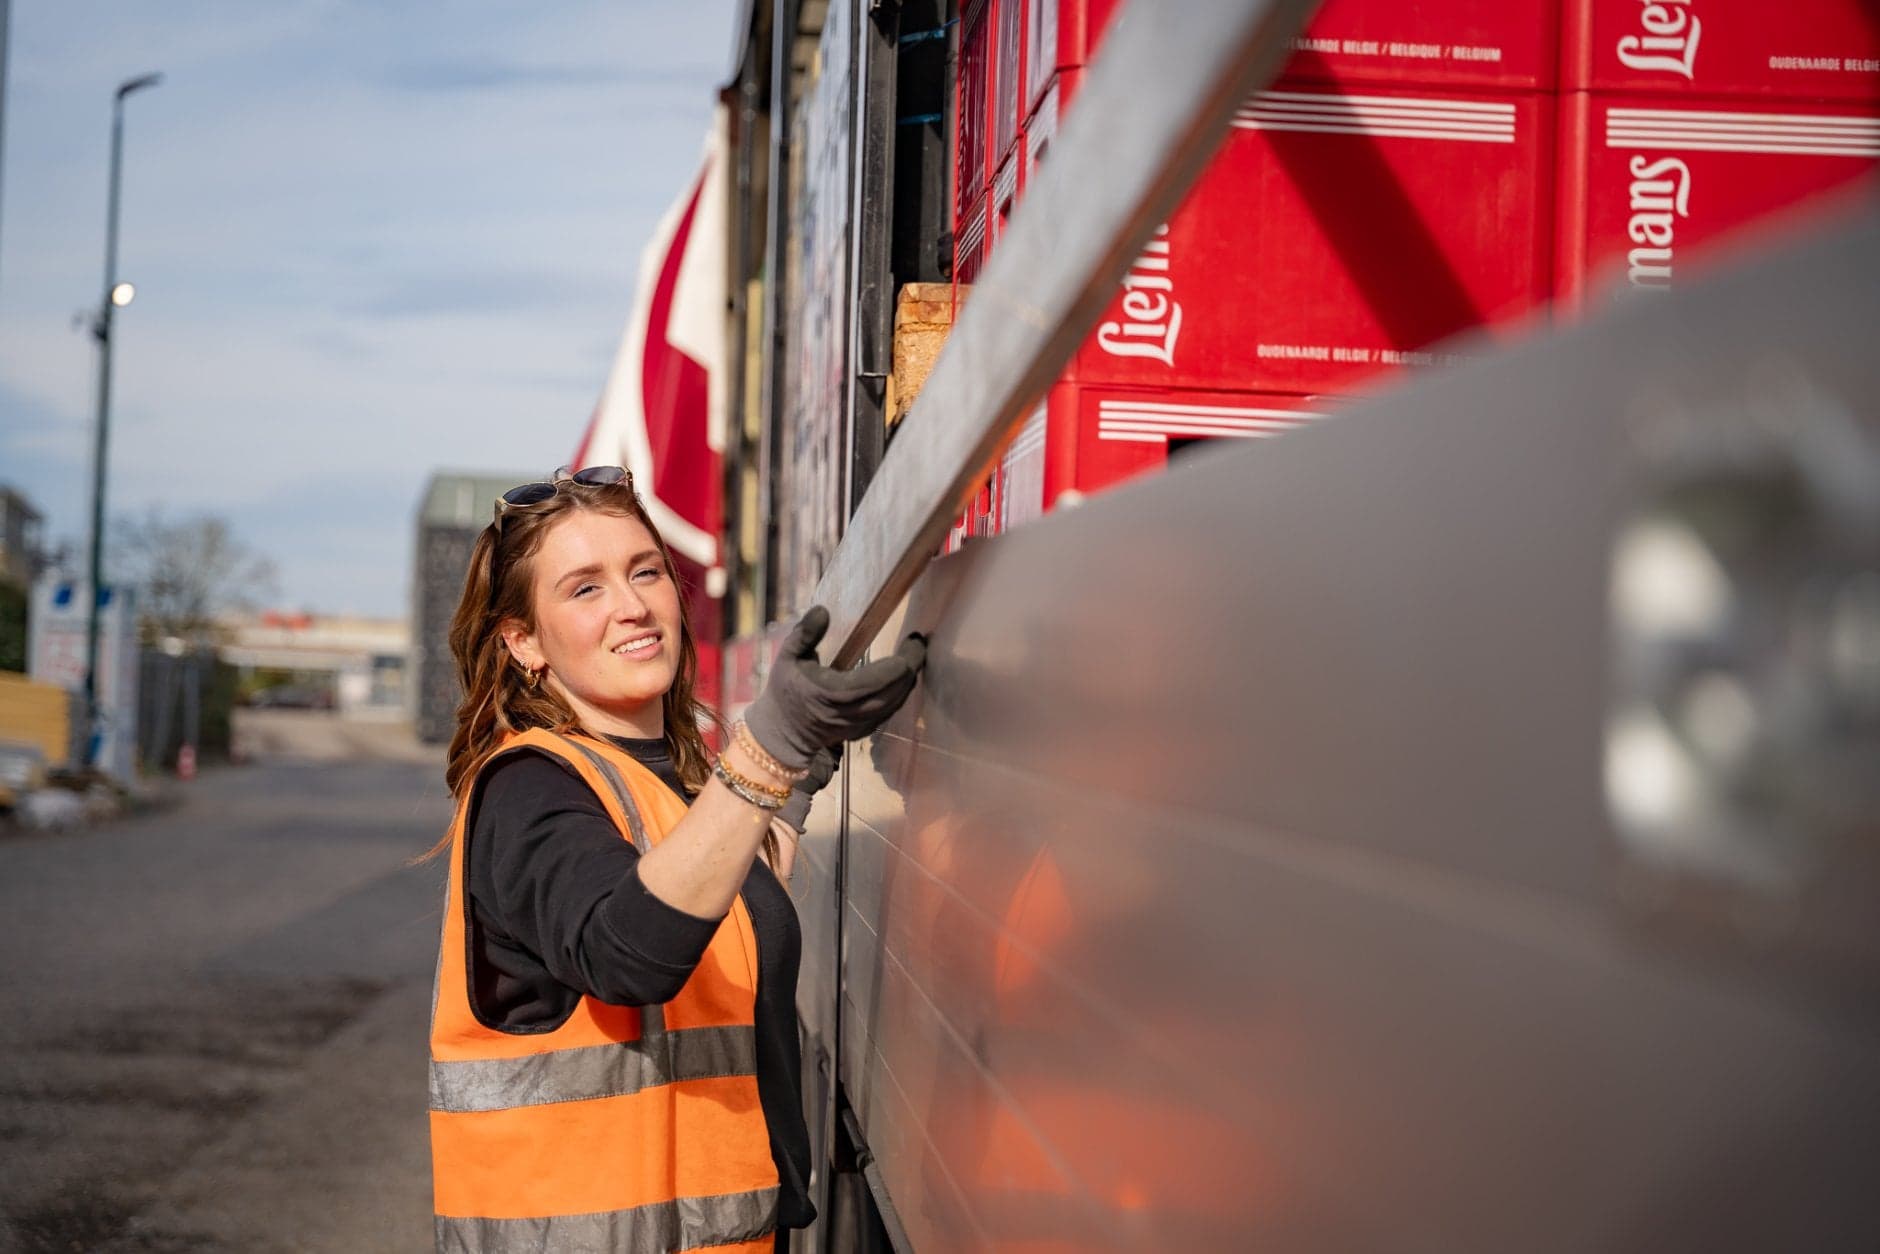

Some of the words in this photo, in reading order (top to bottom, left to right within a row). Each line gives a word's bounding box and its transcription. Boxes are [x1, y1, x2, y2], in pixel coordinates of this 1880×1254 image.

[1389, 42, 1441, 59] BELGIQUE
[1452, 45, 1502, 62] BELGIUM
[1768, 56, 1840, 70] OUDENAARDE
[1257, 344, 1329, 360] OUDENAARDE
